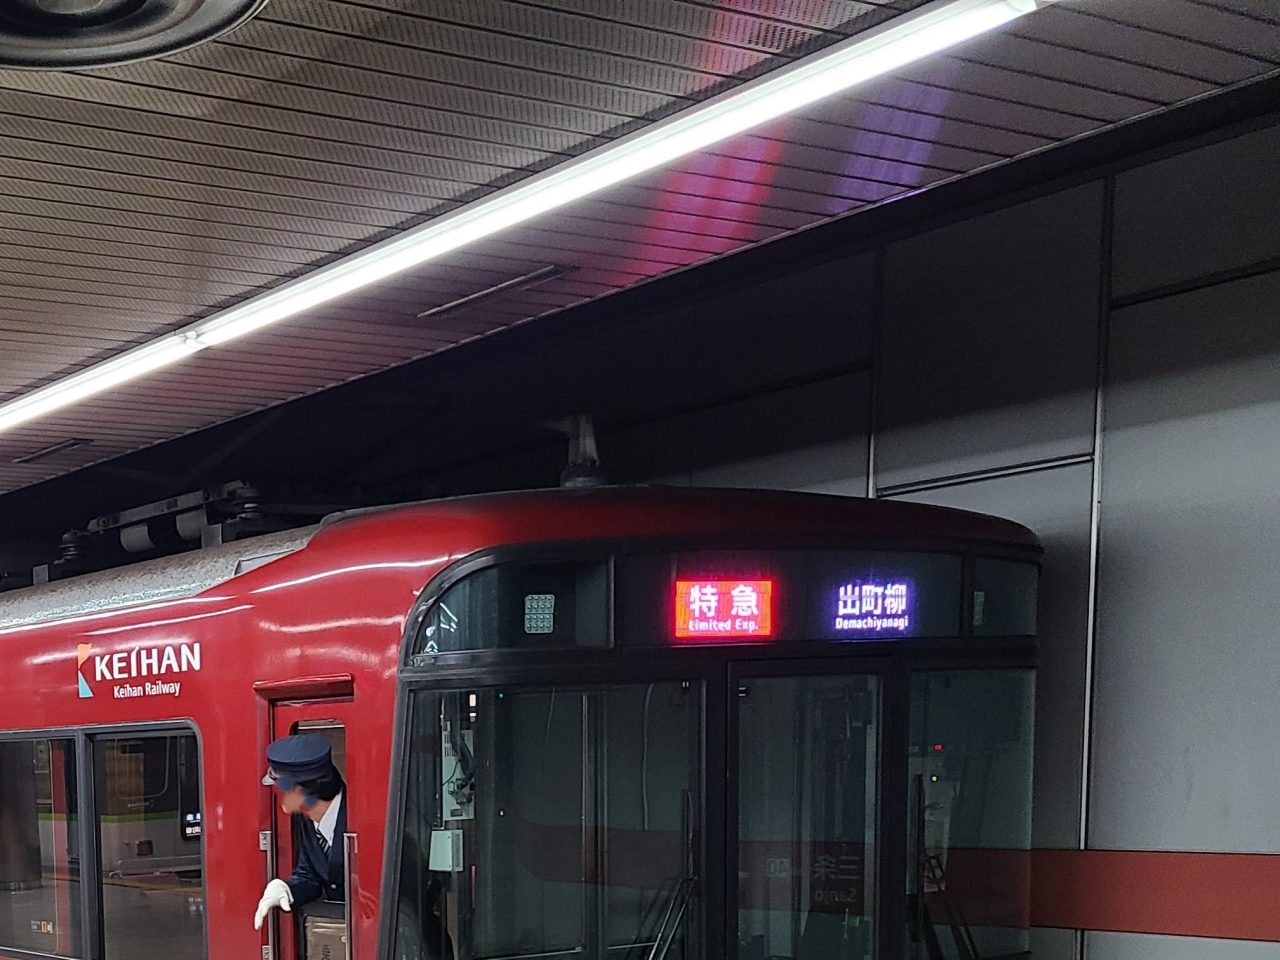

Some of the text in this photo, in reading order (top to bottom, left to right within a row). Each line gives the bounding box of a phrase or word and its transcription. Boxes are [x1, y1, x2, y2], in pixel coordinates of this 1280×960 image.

[689, 584, 759, 618] 特急
[838, 583, 907, 616] 出町柳
[688, 618, 759, 634] Limited Exp.
[835, 615, 909, 631] Demachiyanagi
[94, 642, 201, 682] KEIHAN
[113, 680, 180, 699] Keihan Railway
